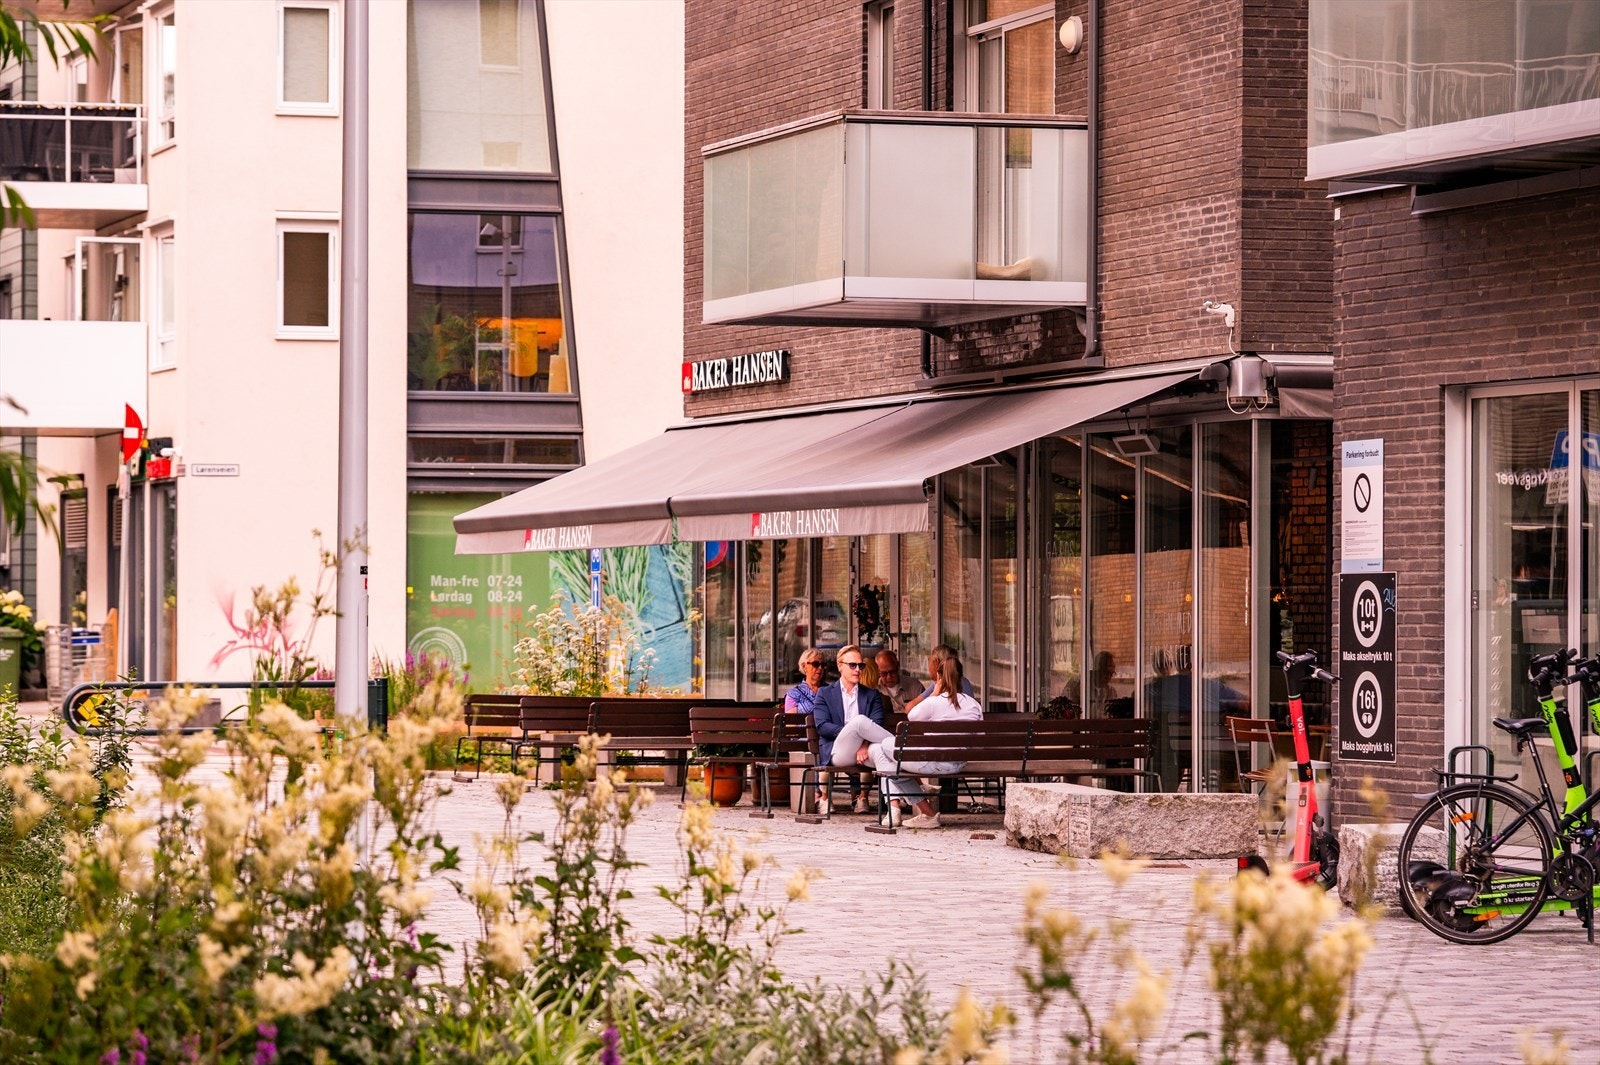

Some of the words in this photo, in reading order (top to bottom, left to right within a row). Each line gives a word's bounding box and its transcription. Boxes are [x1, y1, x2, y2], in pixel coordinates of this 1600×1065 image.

[692, 358, 729, 391] BAKER
[732, 350, 783, 386] HANSEN
[1346, 451, 1364, 459] Parkering
[760, 511, 793, 536] BAKER
[795, 508, 839, 535] HANSEN
[531, 528, 556, 550] BAKER
[558, 525, 593, 548] HANSEN
[430, 575, 479, 587] Man-fre
[487, 575, 523, 587] 07-24
[430, 590, 473, 604] Lørdag
[487, 590, 523, 602] 08-24
[1359, 598, 1376, 618] 10t
[1342, 651, 1356, 661] Maks
[1357, 651, 1382, 663] akseltrykk
[1383, 651, 1389, 661] 10
[1359, 690, 1376, 710] 16t
[1341, 741, 1355, 751] Maks
[1356, 742, 1382, 754] boggitrykk
[1383, 742, 1389, 752] 16
